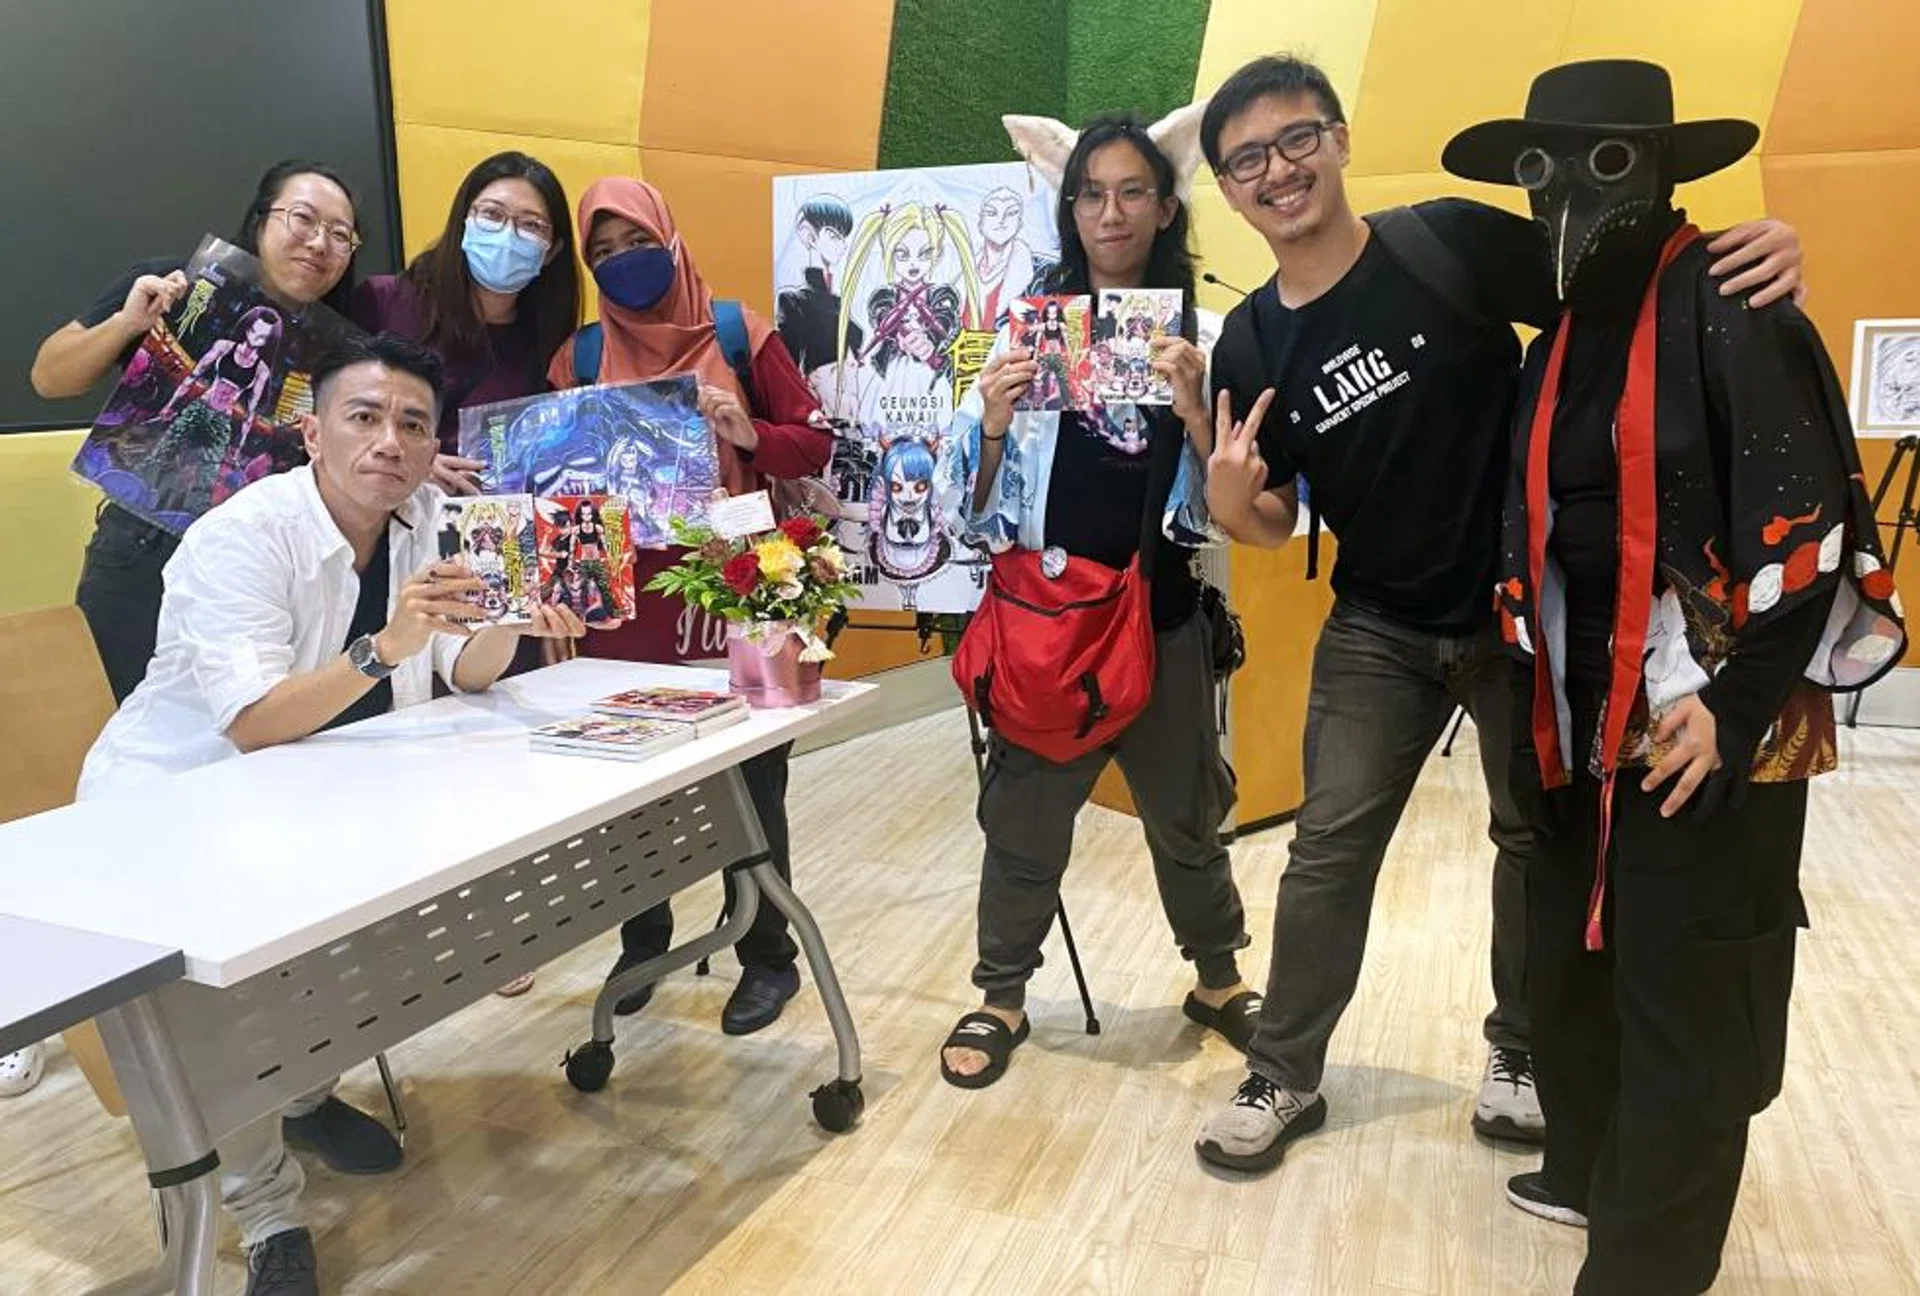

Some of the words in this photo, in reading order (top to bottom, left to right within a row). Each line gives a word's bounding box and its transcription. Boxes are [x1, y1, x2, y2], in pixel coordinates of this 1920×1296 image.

[1313, 348, 1393, 413] LAKG
[1376, 371, 1410, 397] PROJECT
[880, 396, 944, 409] GEUNGSI
[885, 411, 938, 423] KAWAII
